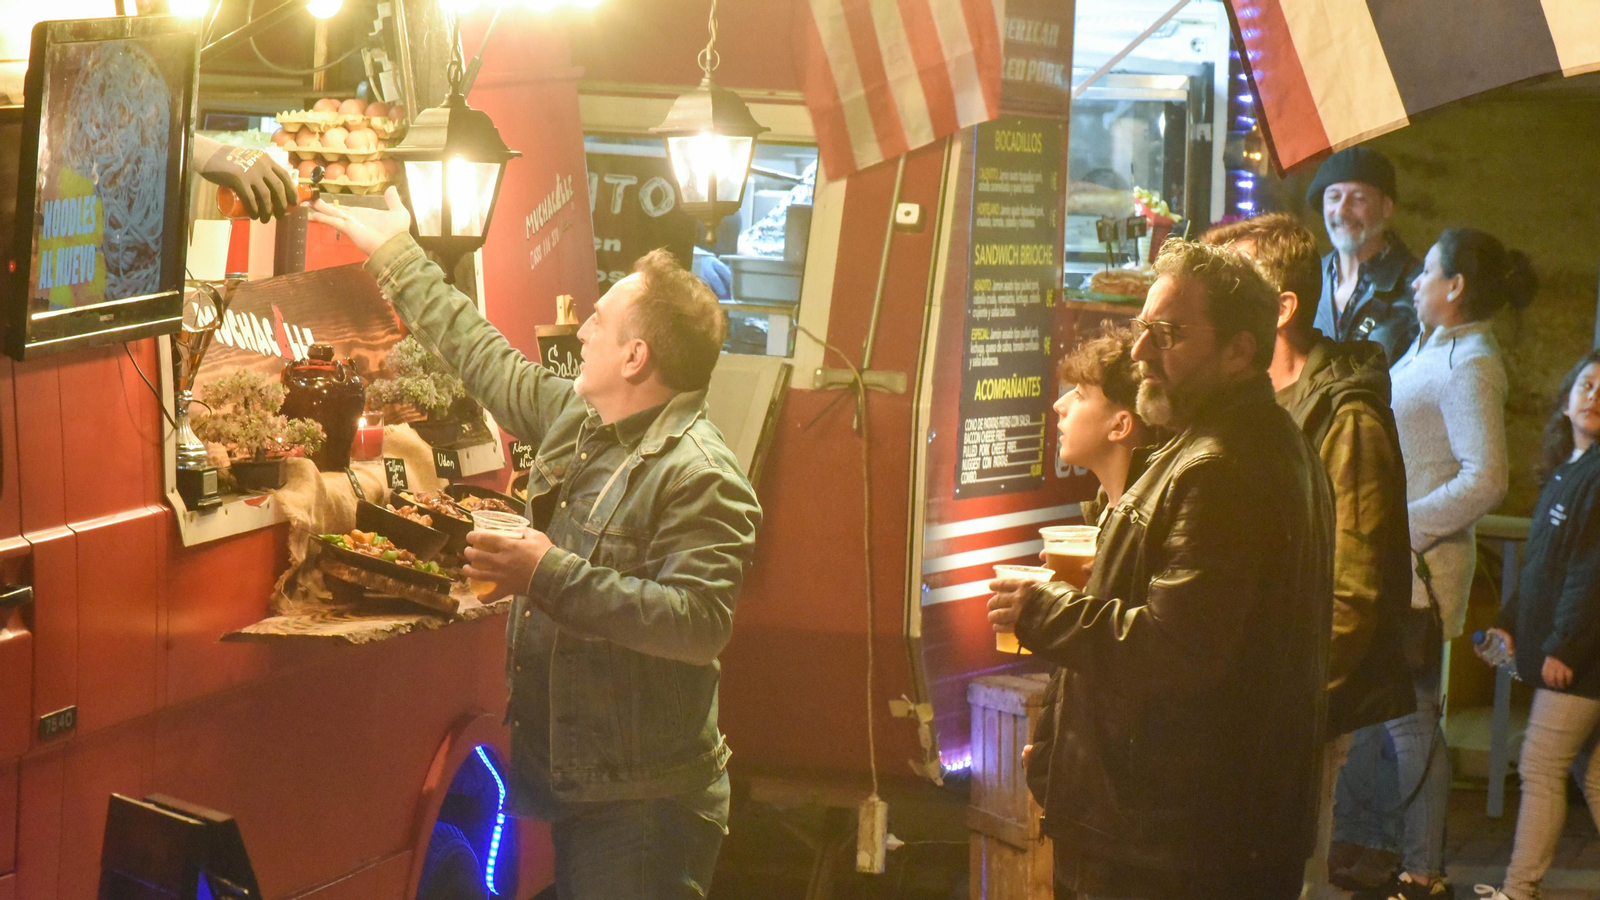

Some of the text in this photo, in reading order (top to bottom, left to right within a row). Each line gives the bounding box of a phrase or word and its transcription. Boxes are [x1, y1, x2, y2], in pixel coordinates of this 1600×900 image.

[995, 130, 1042, 154] BOCADILLOS
[43, 195, 96, 239] NOODLES
[39, 249, 53, 289] AL
[975, 244, 1053, 265] SANDWICH BRIOCHE
[192, 302, 315, 361] MUCHACALL
[548, 344, 581, 377] Sals
[974, 372, 1041, 400] ACOMPAÑANTES
